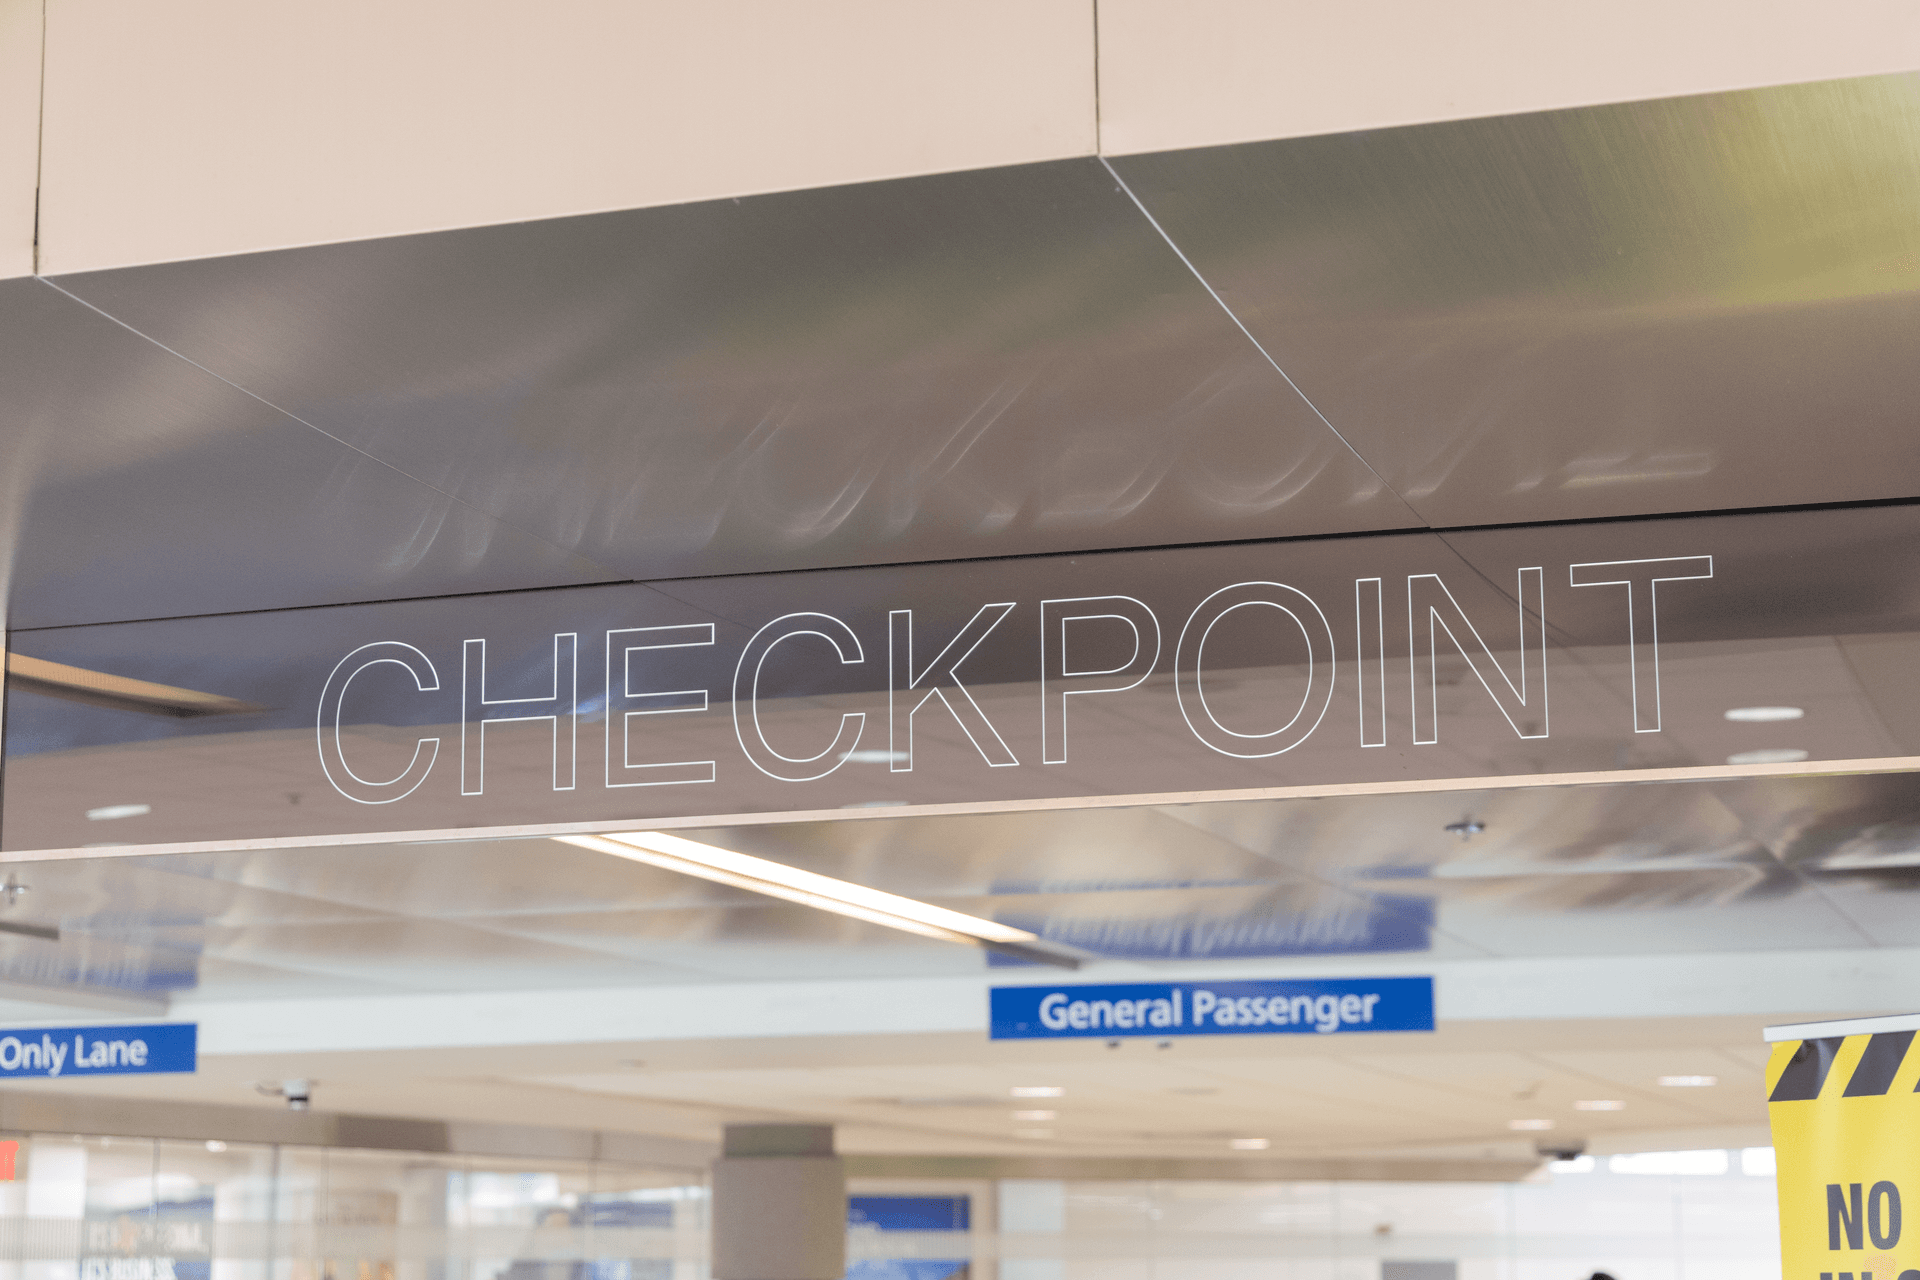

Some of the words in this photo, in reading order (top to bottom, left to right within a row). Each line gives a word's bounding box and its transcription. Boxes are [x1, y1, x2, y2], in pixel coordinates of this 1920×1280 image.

[317, 554, 1716, 805] CHECKPOINT
[1038, 989, 1182, 1030] General
[1192, 989, 1380, 1033] Passenger
[0, 1034, 68, 1077] Only
[74, 1035, 148, 1068] Lane
[1826, 1180, 1902, 1251] NO
